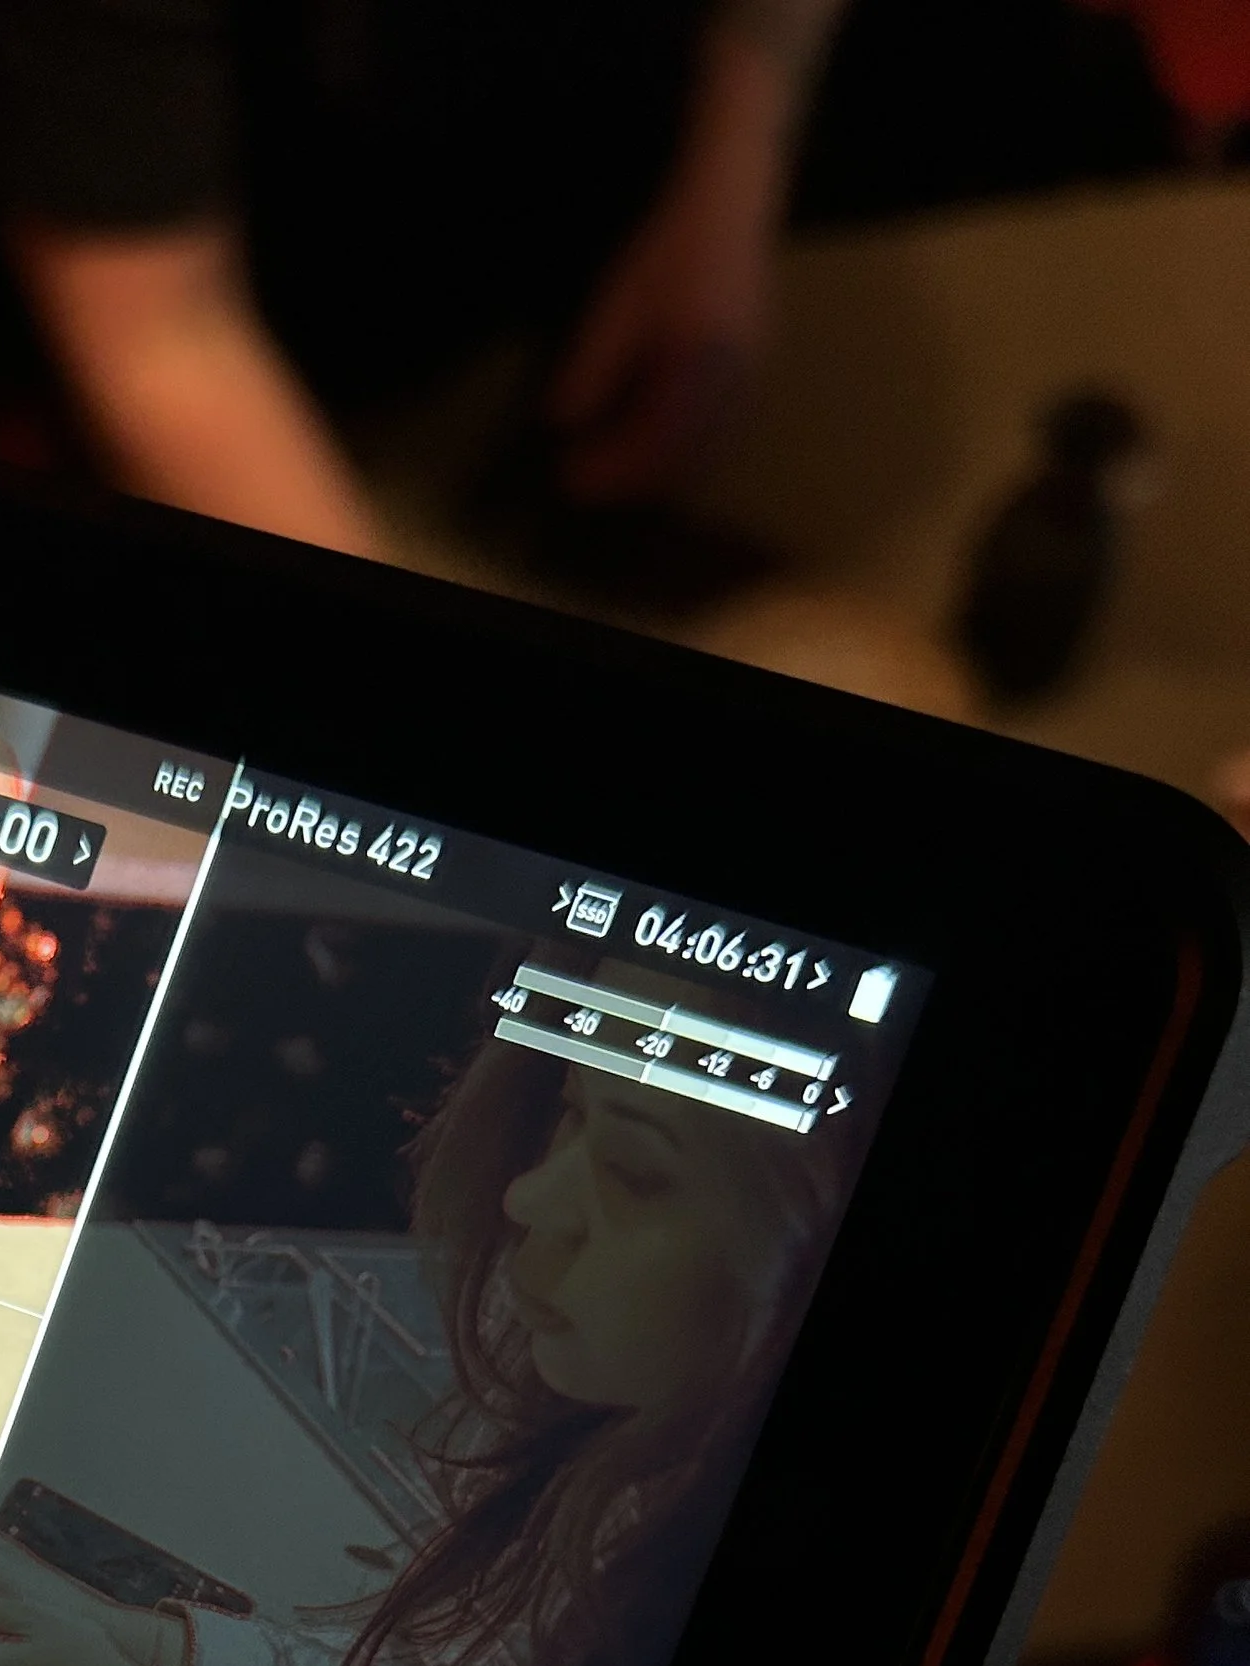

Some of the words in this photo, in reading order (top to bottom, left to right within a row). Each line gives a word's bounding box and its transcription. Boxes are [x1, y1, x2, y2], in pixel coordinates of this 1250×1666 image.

[154, 762, 205, 802] REC
[223, 779, 359, 856] ProRes
[366, 826, 442, 880] 422
[576, 901, 608, 925] SSD
[634, 906, 808, 990] 04:06:31
[491, 986, 529, 1013] -40
[564, 1008, 601, 1036] -30
[636, 1032, 674, 1059] -20
[698, 1050, 735, 1077] -12
[750, 1068, 779, 1091] -6
